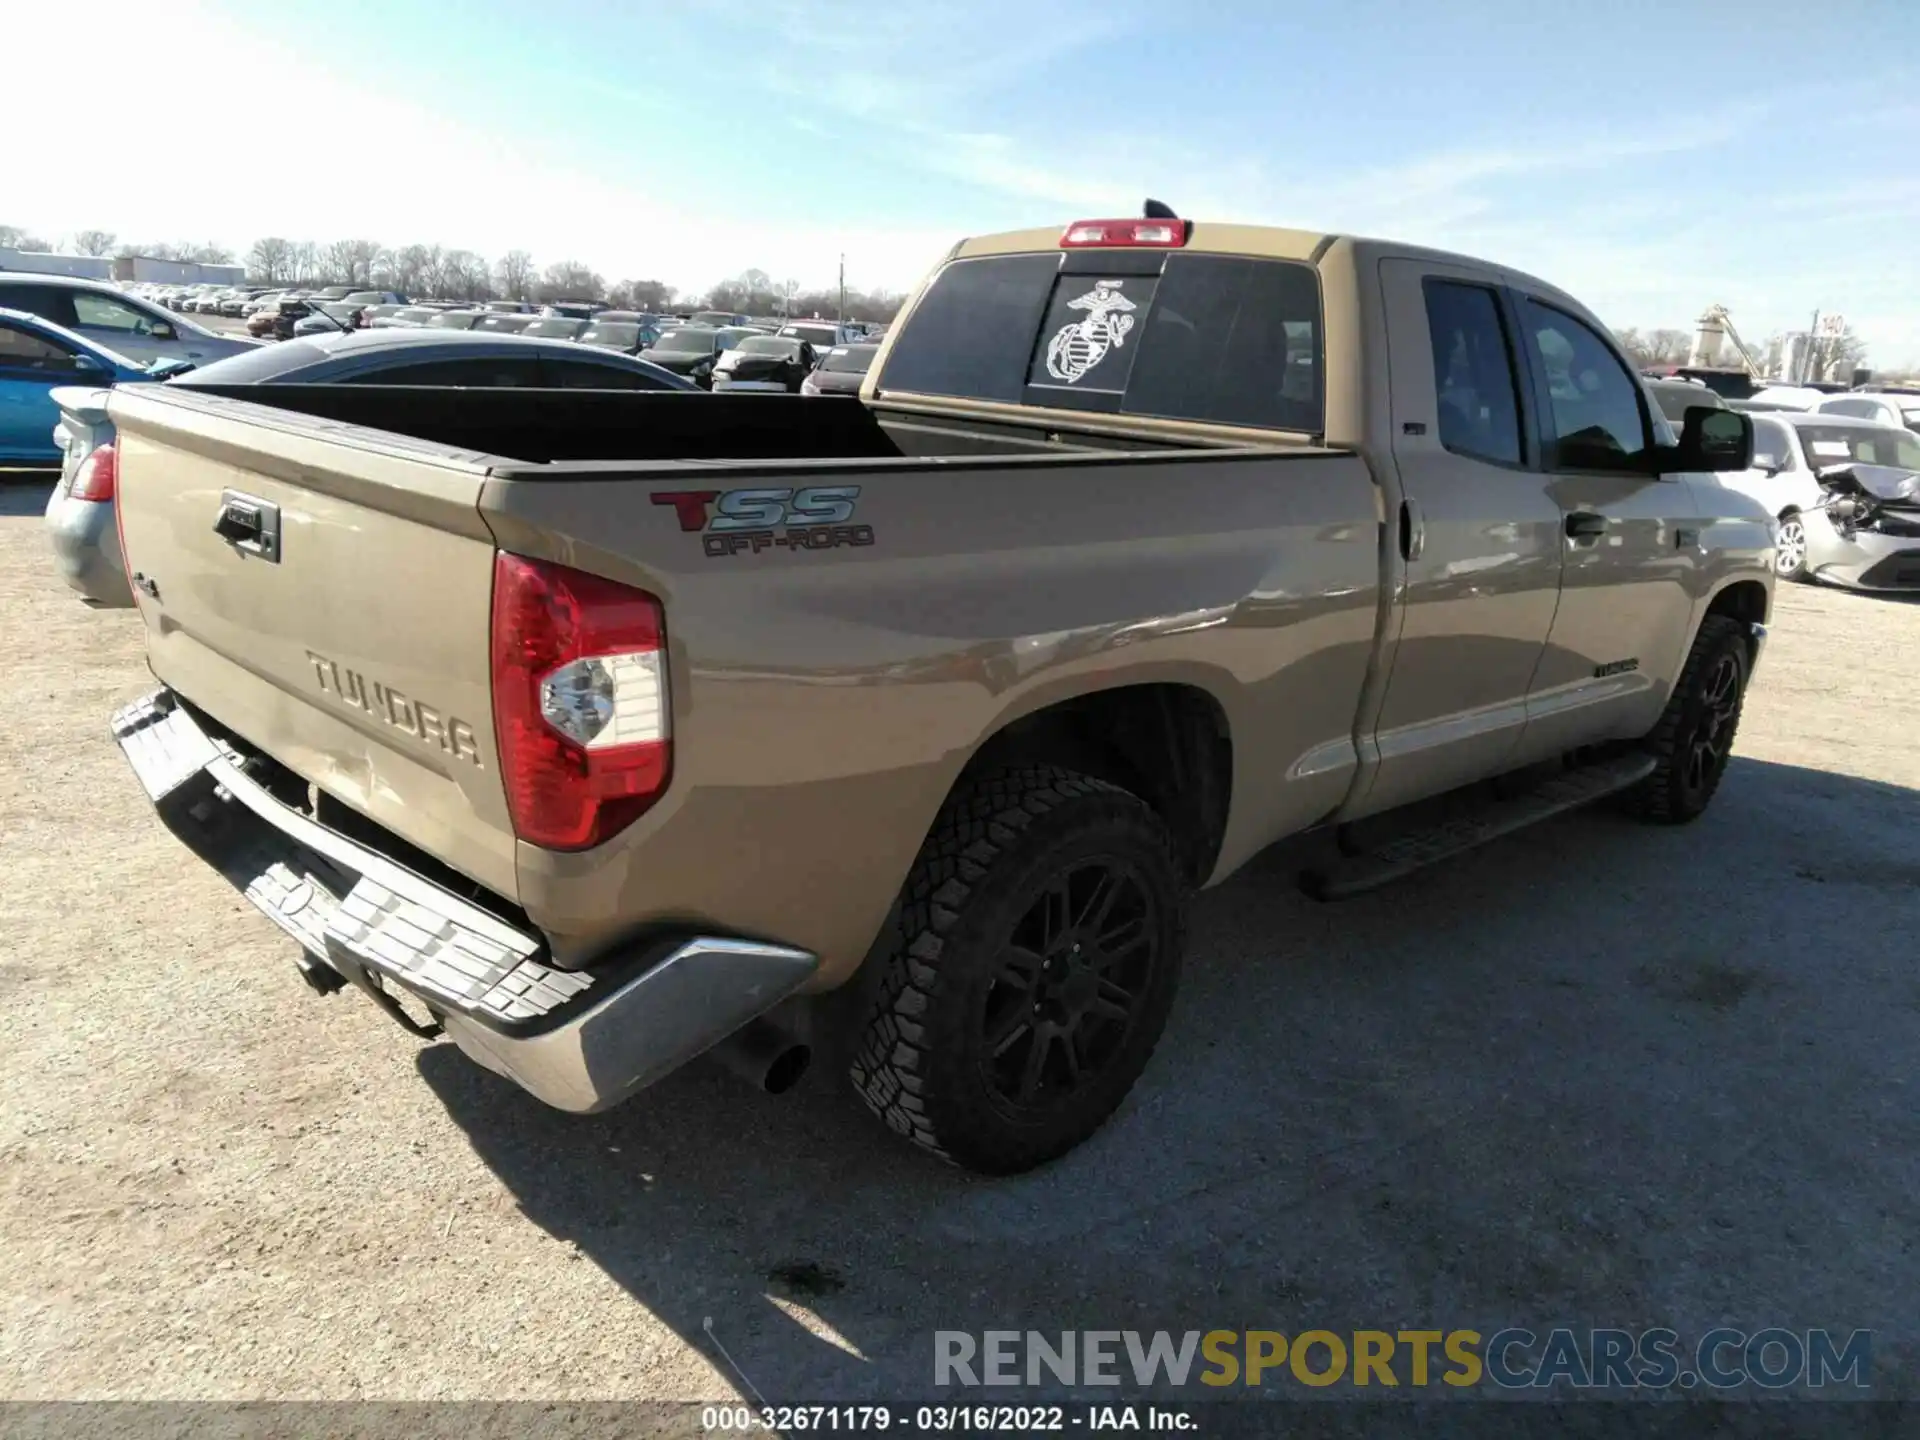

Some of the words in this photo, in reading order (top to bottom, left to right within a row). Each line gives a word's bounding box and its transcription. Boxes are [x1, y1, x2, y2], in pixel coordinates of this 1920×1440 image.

[650, 485, 862, 531] TSS
[702, 524, 875, 557] OFF-ROAD
[305, 650, 485, 769] TUNDRA
